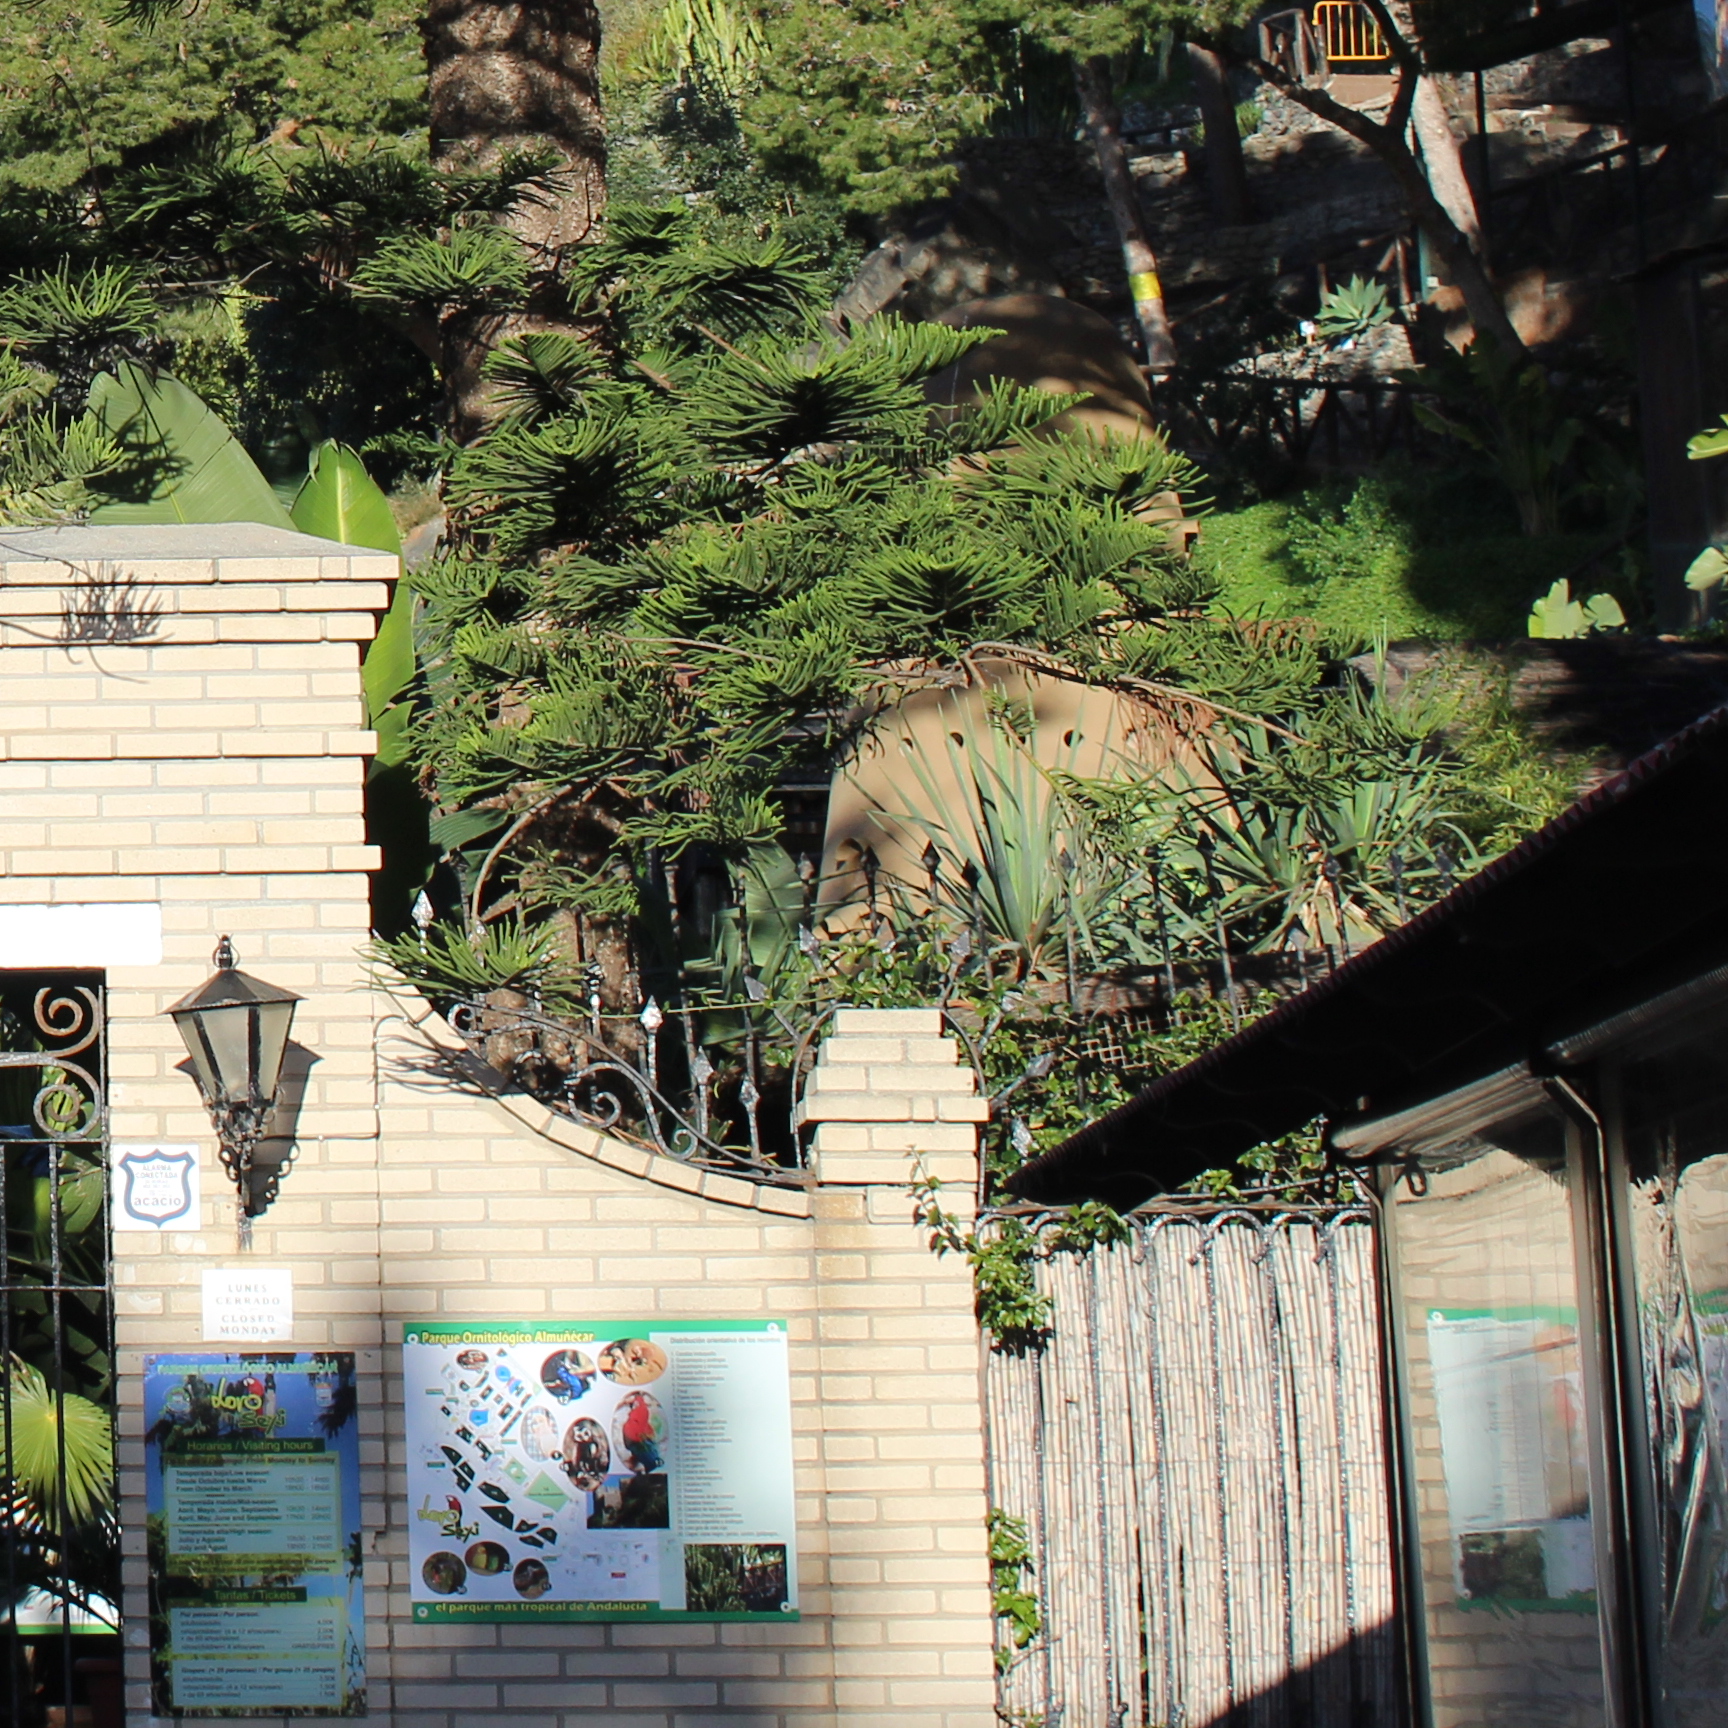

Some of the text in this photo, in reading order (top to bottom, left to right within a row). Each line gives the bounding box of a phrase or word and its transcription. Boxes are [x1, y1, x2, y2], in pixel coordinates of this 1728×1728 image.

[133, 1194, 182, 1206] acacio
[227, 1284, 267, 1293] LUNES
[215, 1296, 281, 1306] CERRADO
[221, 1314, 275, 1324] CLOSED
[219, 1325, 277, 1335] MONDAY
[421, 1328, 594, 1348] Parque Ornitológico Almuñécar
[243, 1440, 281, 1452] Visiting
[283, 1439, 314, 1450] hours
[440, 1522, 481, 1544] Sexi
[260, 1589, 297, 1601] Tickets
[435, 1600, 447, 1612] el
[448, 1603, 492, 1617] parque
[494, 1599, 518, 1612] más
[520, 1600, 566, 1616] tropical
[569, 1599, 585, 1611] de
